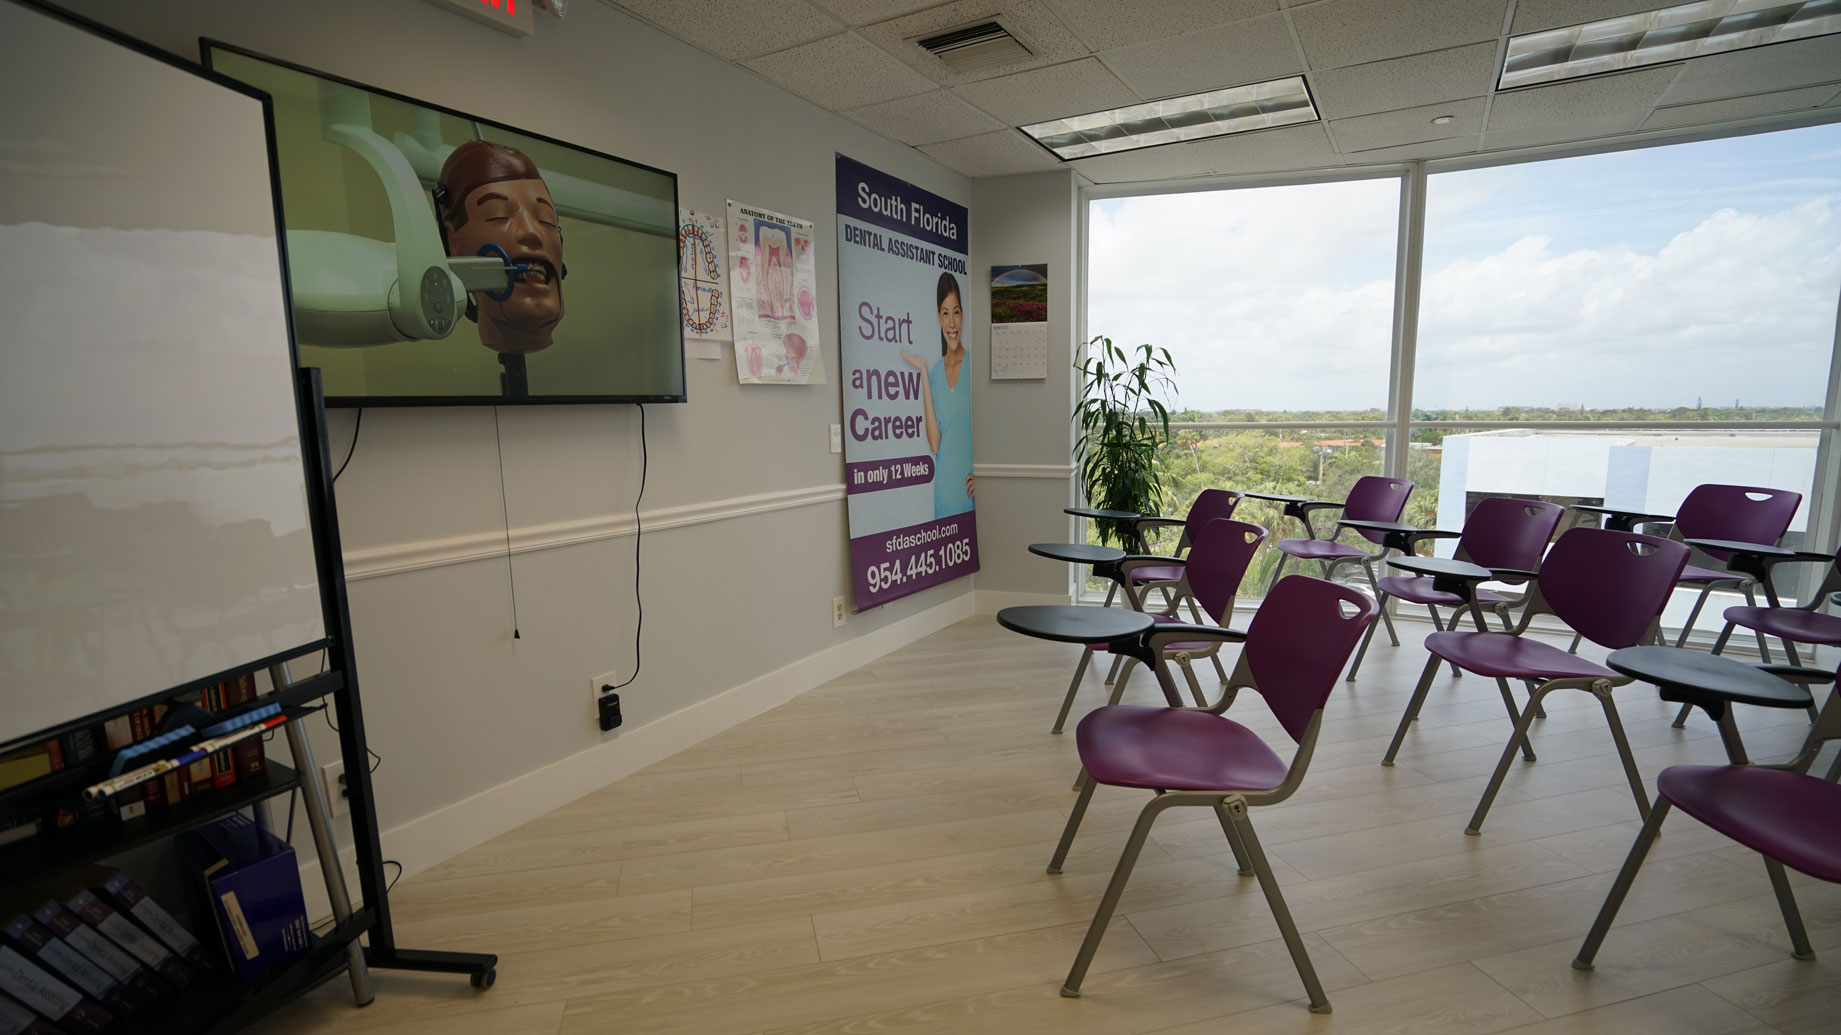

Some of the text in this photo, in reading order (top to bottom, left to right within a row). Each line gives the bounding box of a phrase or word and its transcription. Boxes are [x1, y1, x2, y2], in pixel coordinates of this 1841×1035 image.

[740, 207, 766, 220] ANATOMY
[775, 216, 786, 225] THE
[857, 181, 957, 240] South Florida
[844, 223, 968, 276] DENTAL ASSISTANT SCHOOL
[858, 301, 913, 344] Start
[849, 407, 923, 442] Career
[853, 461, 929, 484] in only 12 Weeks
[885, 523, 959, 553] sfdaschool.com
[866, 538, 971, 593] 954.445.1085
